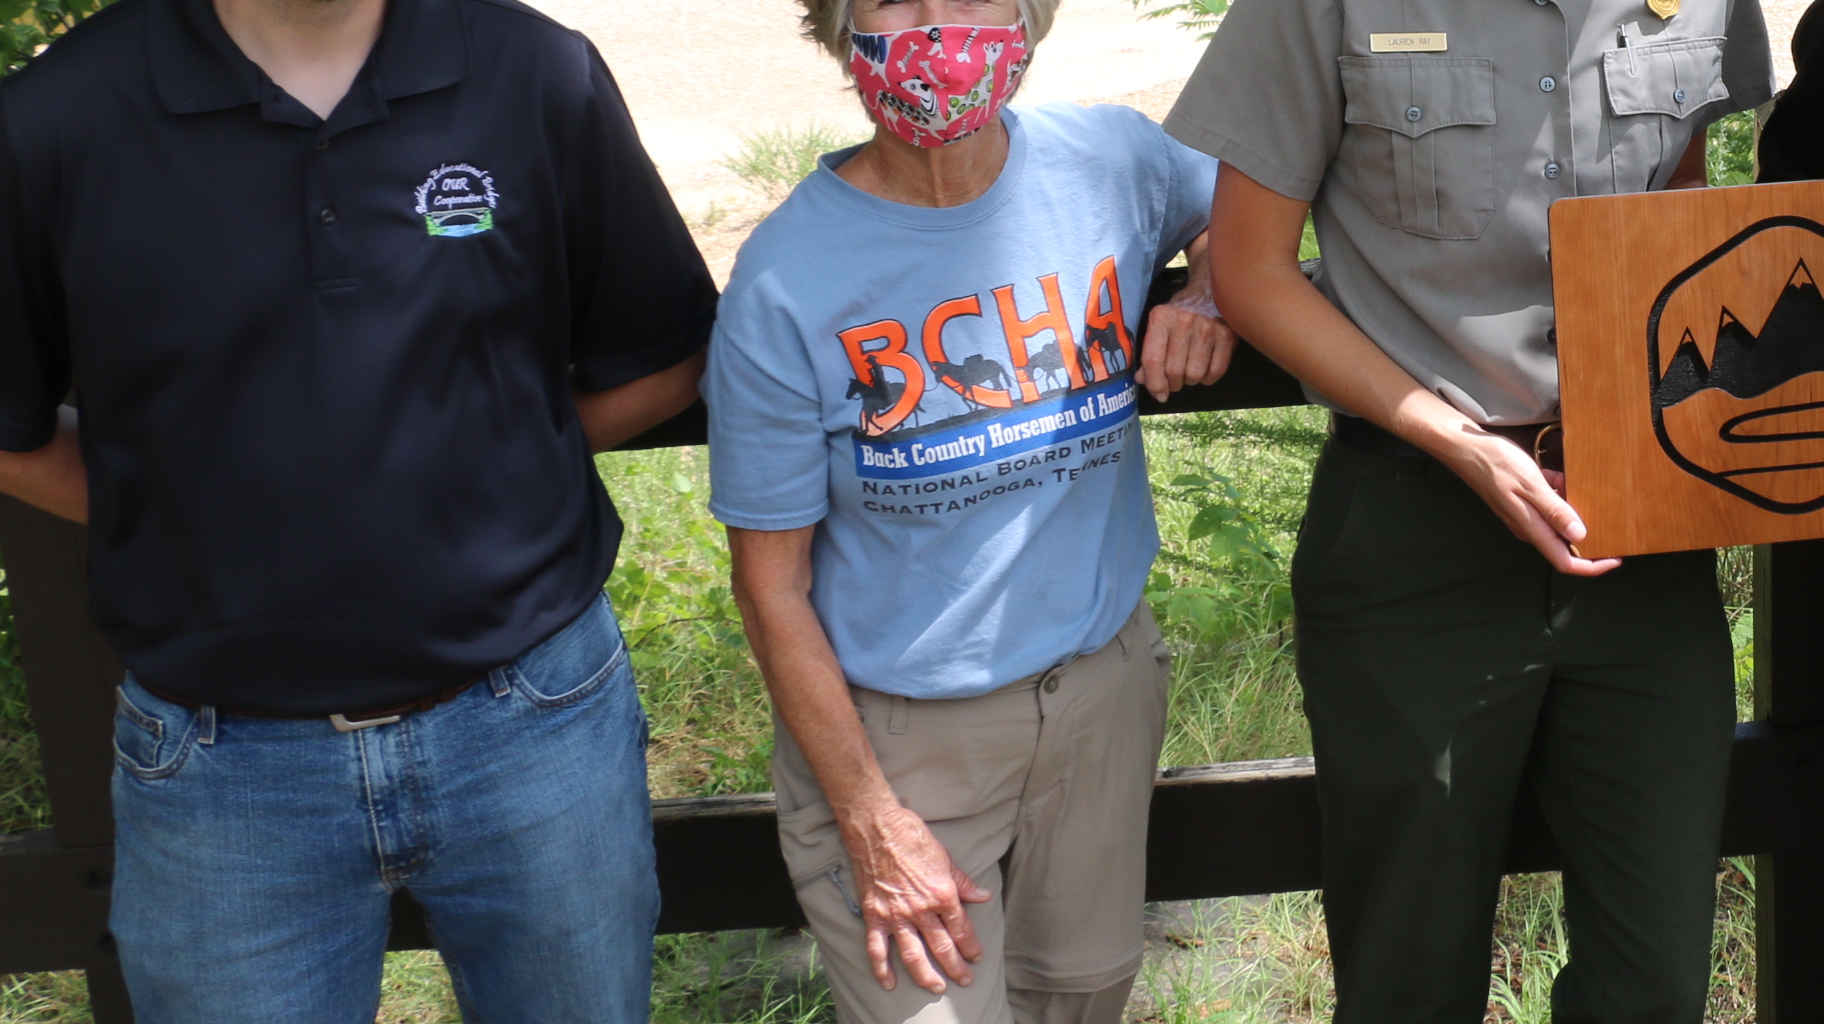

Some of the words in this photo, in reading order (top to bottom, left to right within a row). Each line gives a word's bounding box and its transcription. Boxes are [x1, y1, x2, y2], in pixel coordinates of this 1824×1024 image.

[1388, 38, 1415, 46] LAUREN
[1418, 37, 1431, 45] RAY
[441, 177, 471, 191] OUR
[837, 255, 1133, 437] BCHA
[861, 444, 909, 469] Back
[913, 435, 986, 466] Country
[987, 408, 1078, 449] Horsemen
[1080, 396, 1097, 422] of
[862, 471, 988, 496] NATIONAL
[997, 445, 1071, 476] BOARD
[863, 477, 1044, 514] CHATTANOOGA,
